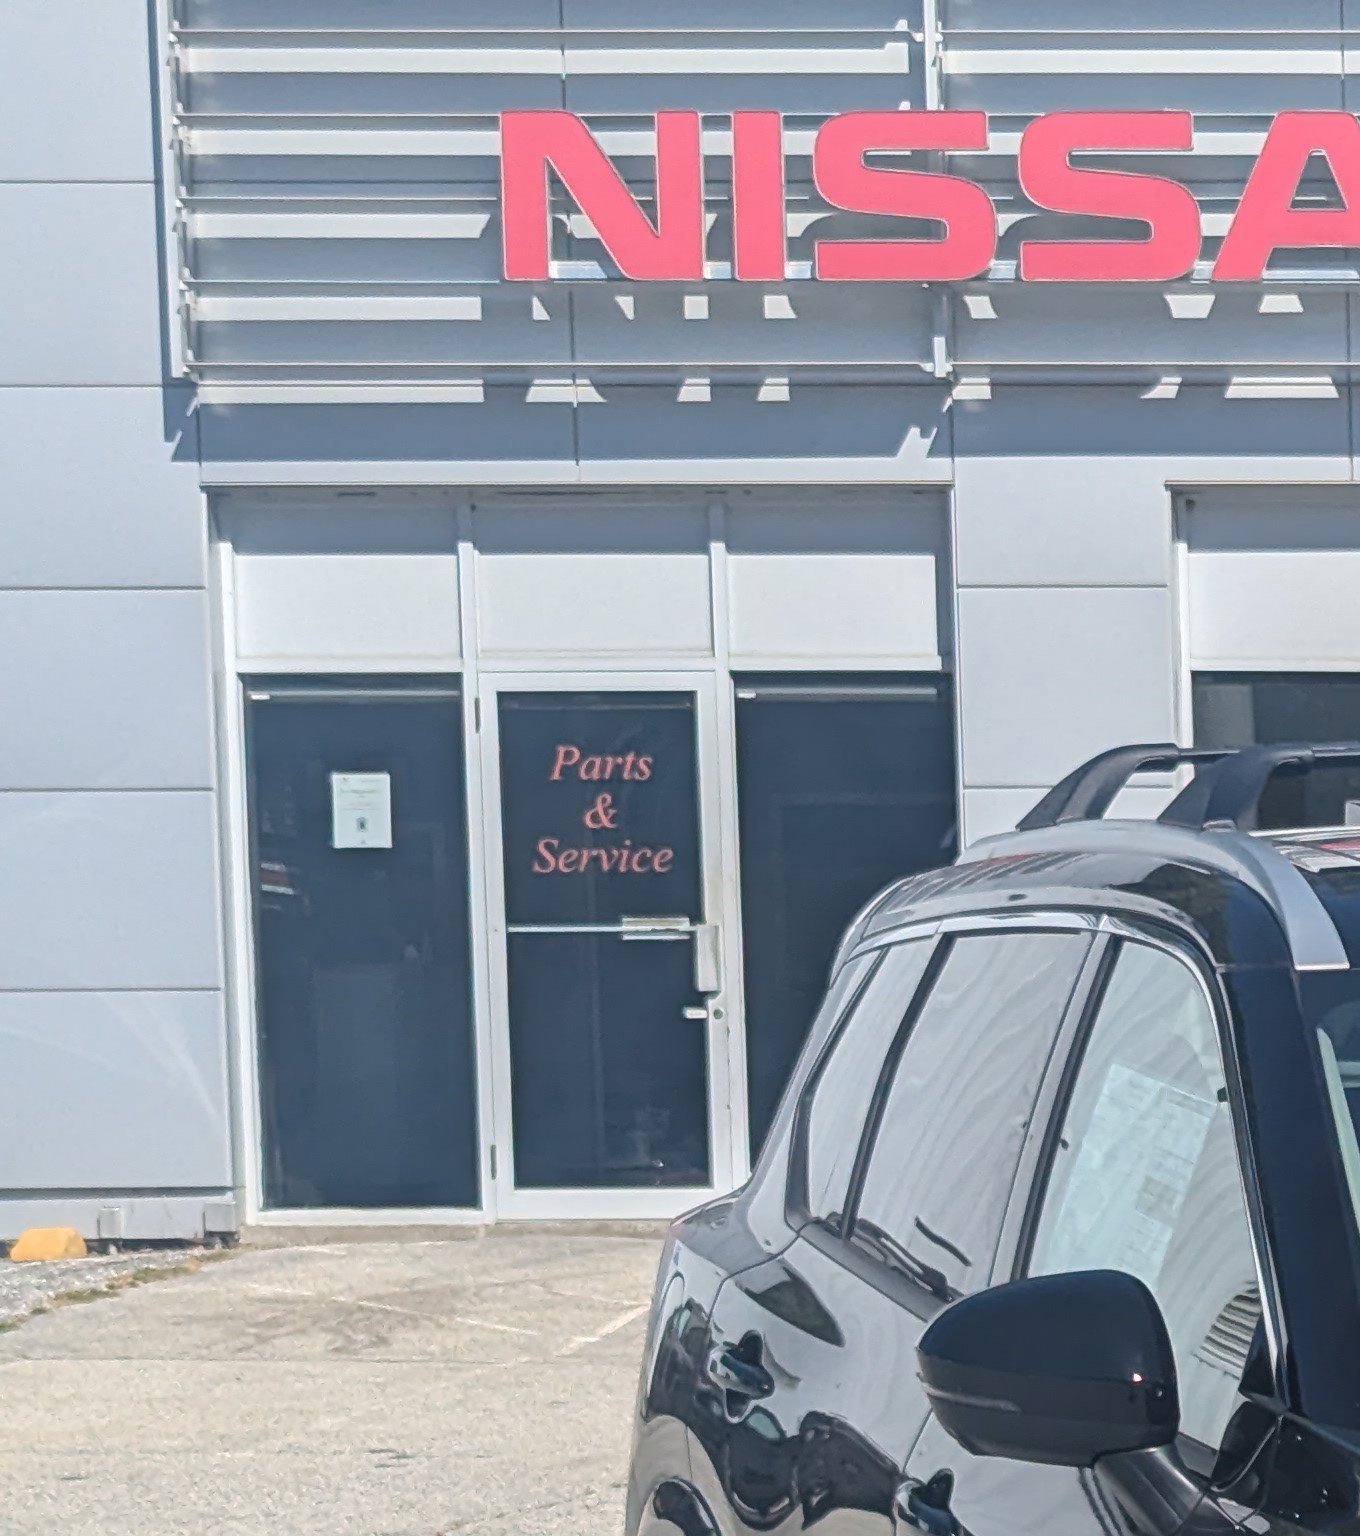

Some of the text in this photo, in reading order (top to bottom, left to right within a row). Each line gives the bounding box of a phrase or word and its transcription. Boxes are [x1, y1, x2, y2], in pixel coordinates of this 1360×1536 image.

[549, 744, 653, 783] Parts
[584, 793, 617, 830] &
[532, 839, 674, 874] Service
